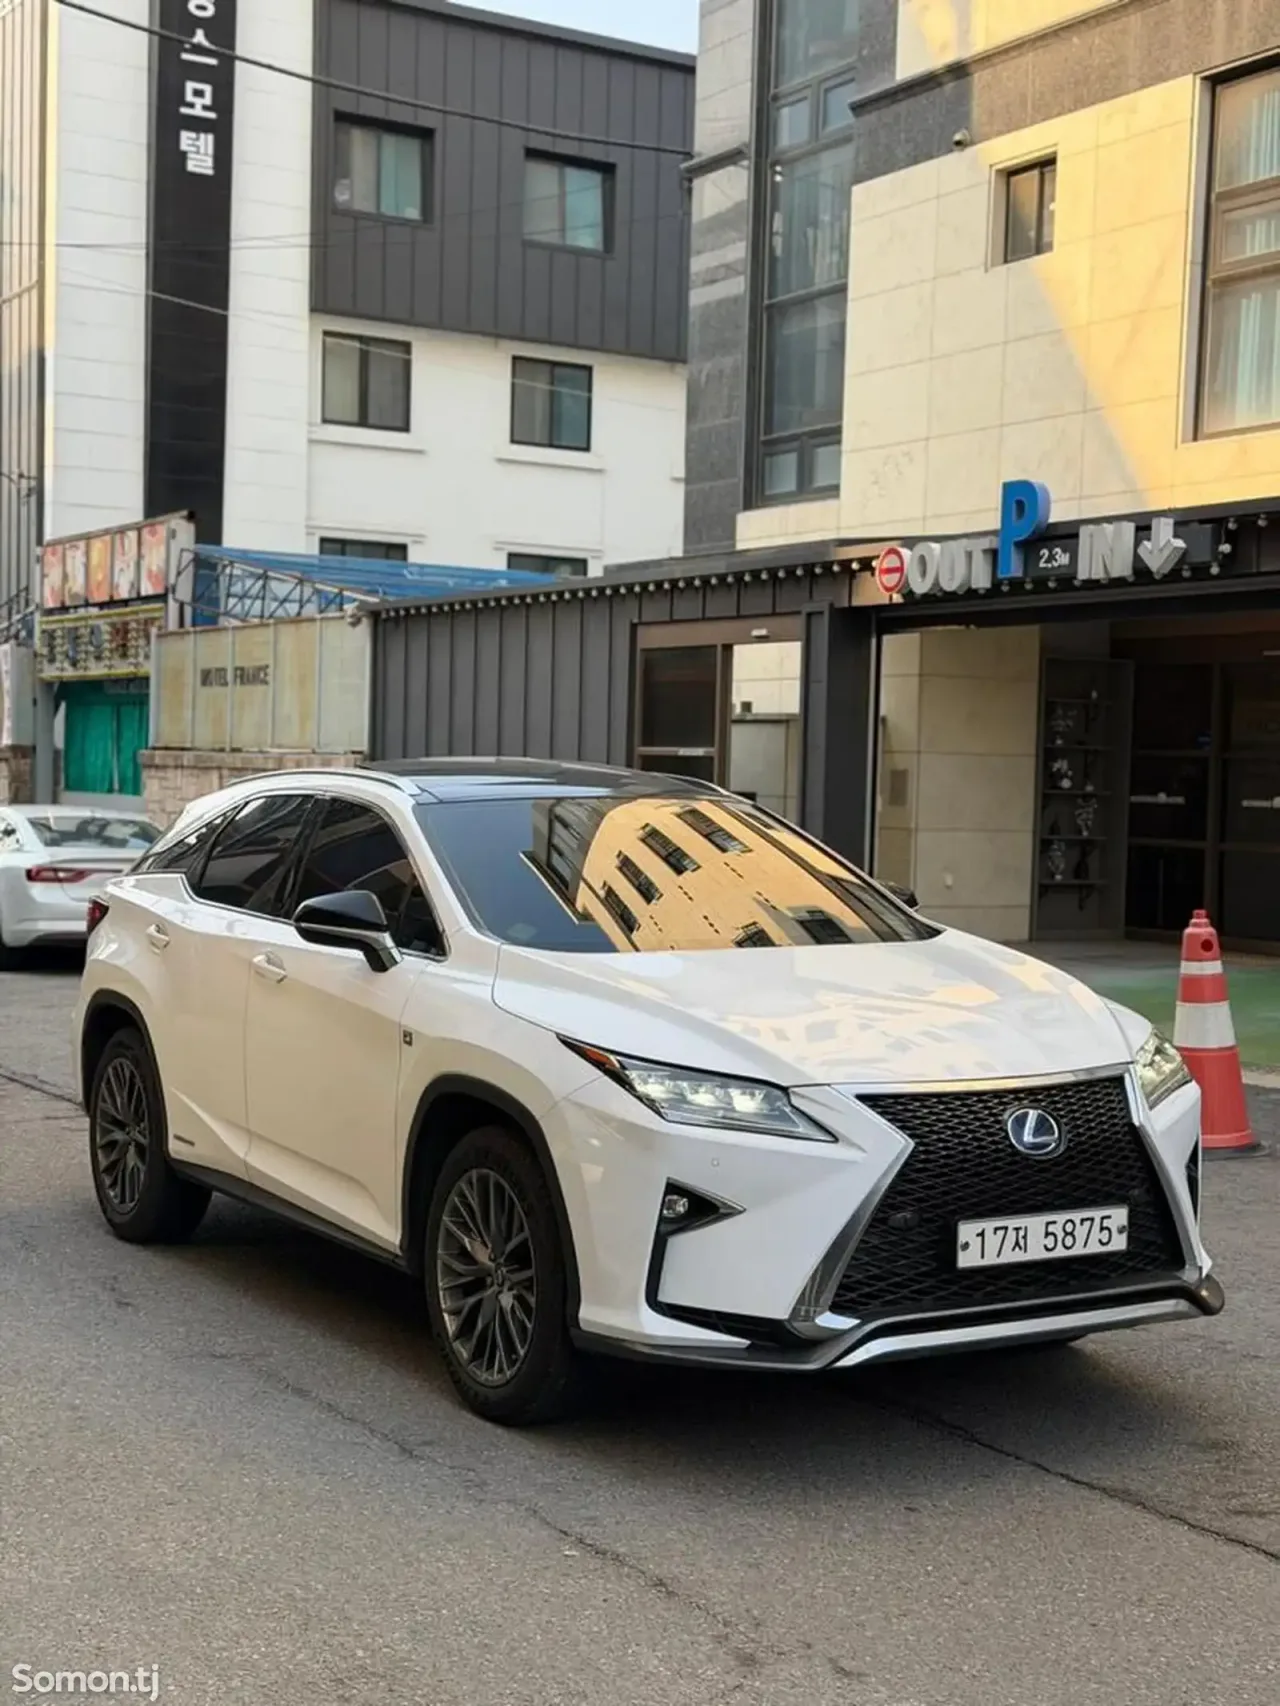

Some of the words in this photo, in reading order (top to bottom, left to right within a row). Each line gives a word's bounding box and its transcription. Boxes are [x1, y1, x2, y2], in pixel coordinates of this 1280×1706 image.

[908, 536, 996, 595] OUT
[998, 479, 1050, 579] P
[1077, 521, 1135, 580] IN
[234, 664, 269, 686] FRANCE
[975, 1225, 1029, 1260] 17저
[1043, 1215, 1113, 1252] 5875
